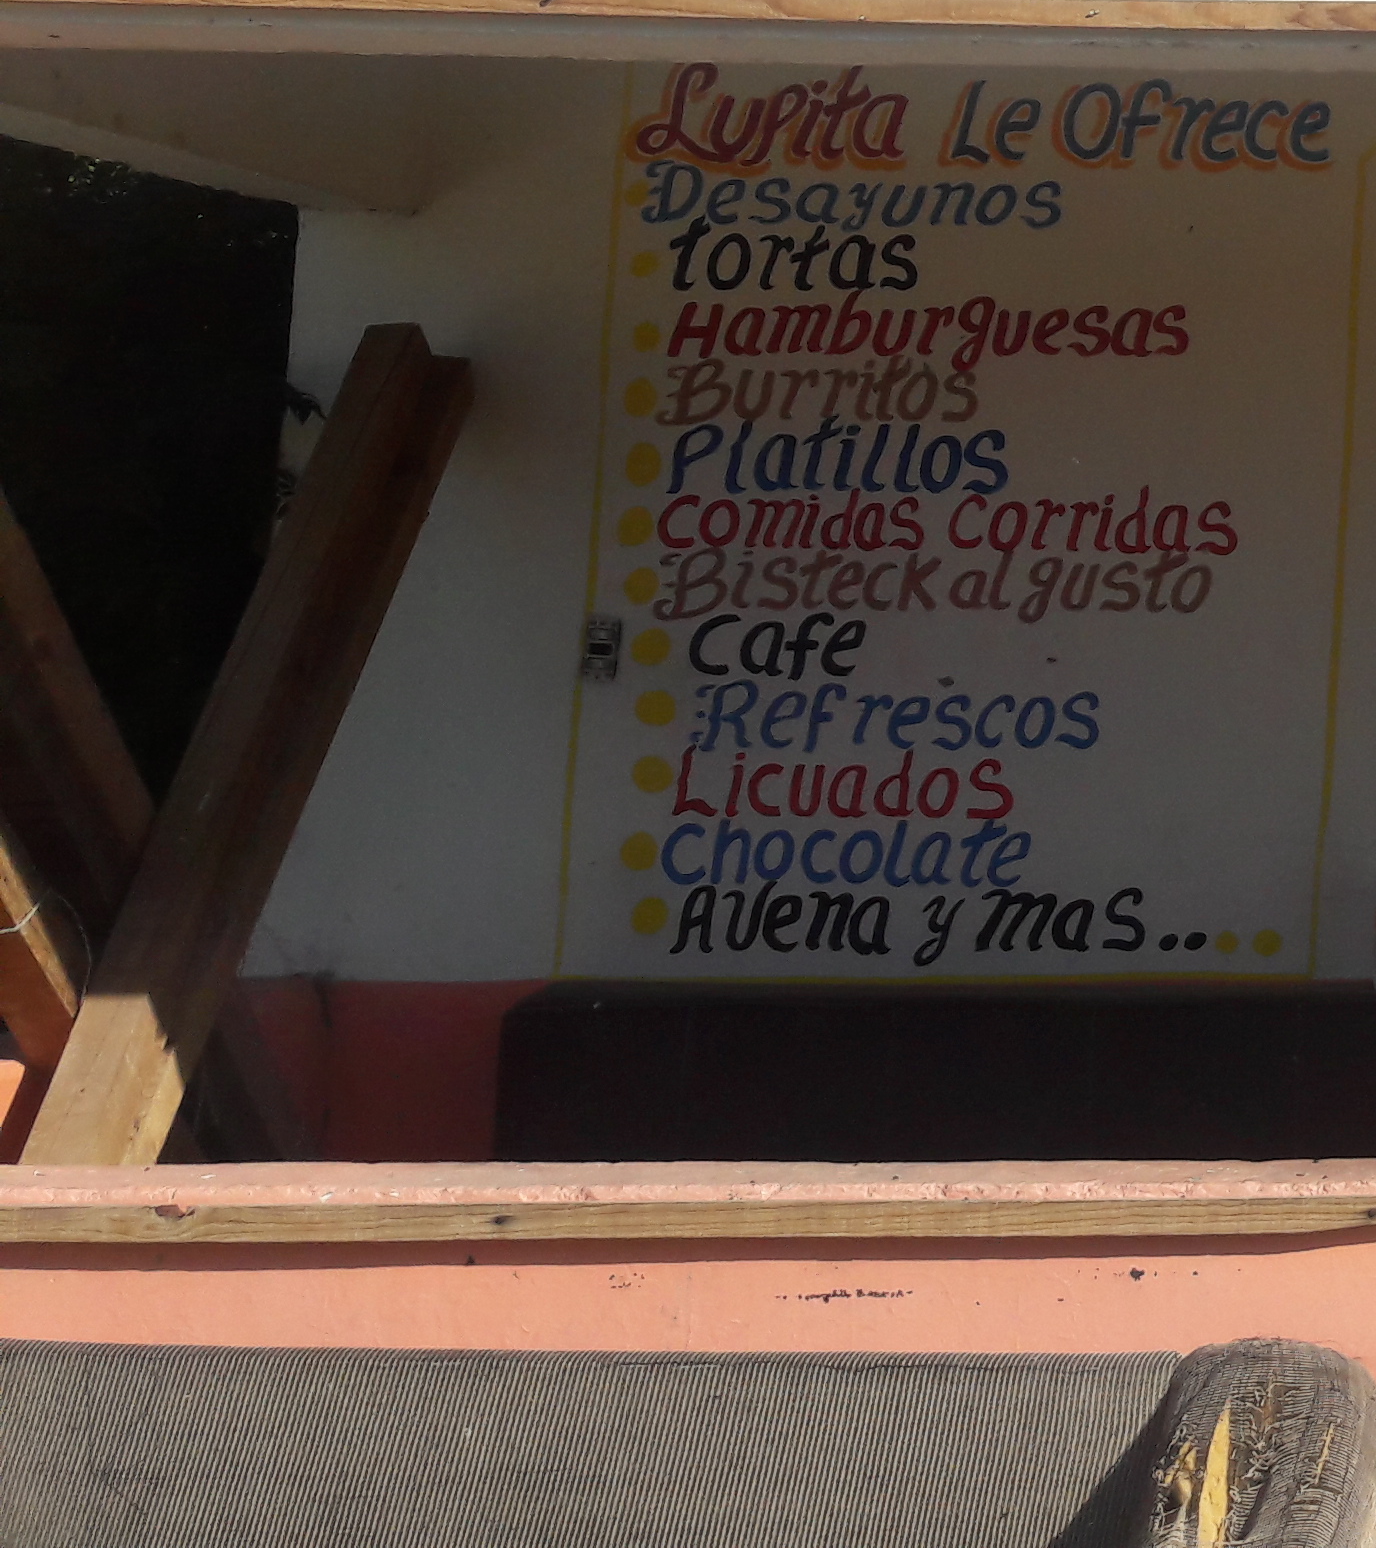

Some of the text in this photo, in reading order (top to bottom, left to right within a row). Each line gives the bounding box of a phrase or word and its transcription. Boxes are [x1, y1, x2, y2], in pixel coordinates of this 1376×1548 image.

[634, 62, 910, 168] Lupita
[942, 80, 1042, 166] Le
[642, 160, 1064, 232] Desayunos
[666, 292, 1192, 372] Hamburguesas
[654, 354, 980, 426] Burritos
[664, 414, 1010, 496] Platillos
[946, 484, 1240, 556] Corridas
[652, 546, 1214, 624] Bisteck al gusto
[694, 680, 1102, 752] Refrescos
[670, 744, 1016, 820] Licuados
[658, 816, 1034, 888] Chocolate
[912, 894, 964, 968] y
